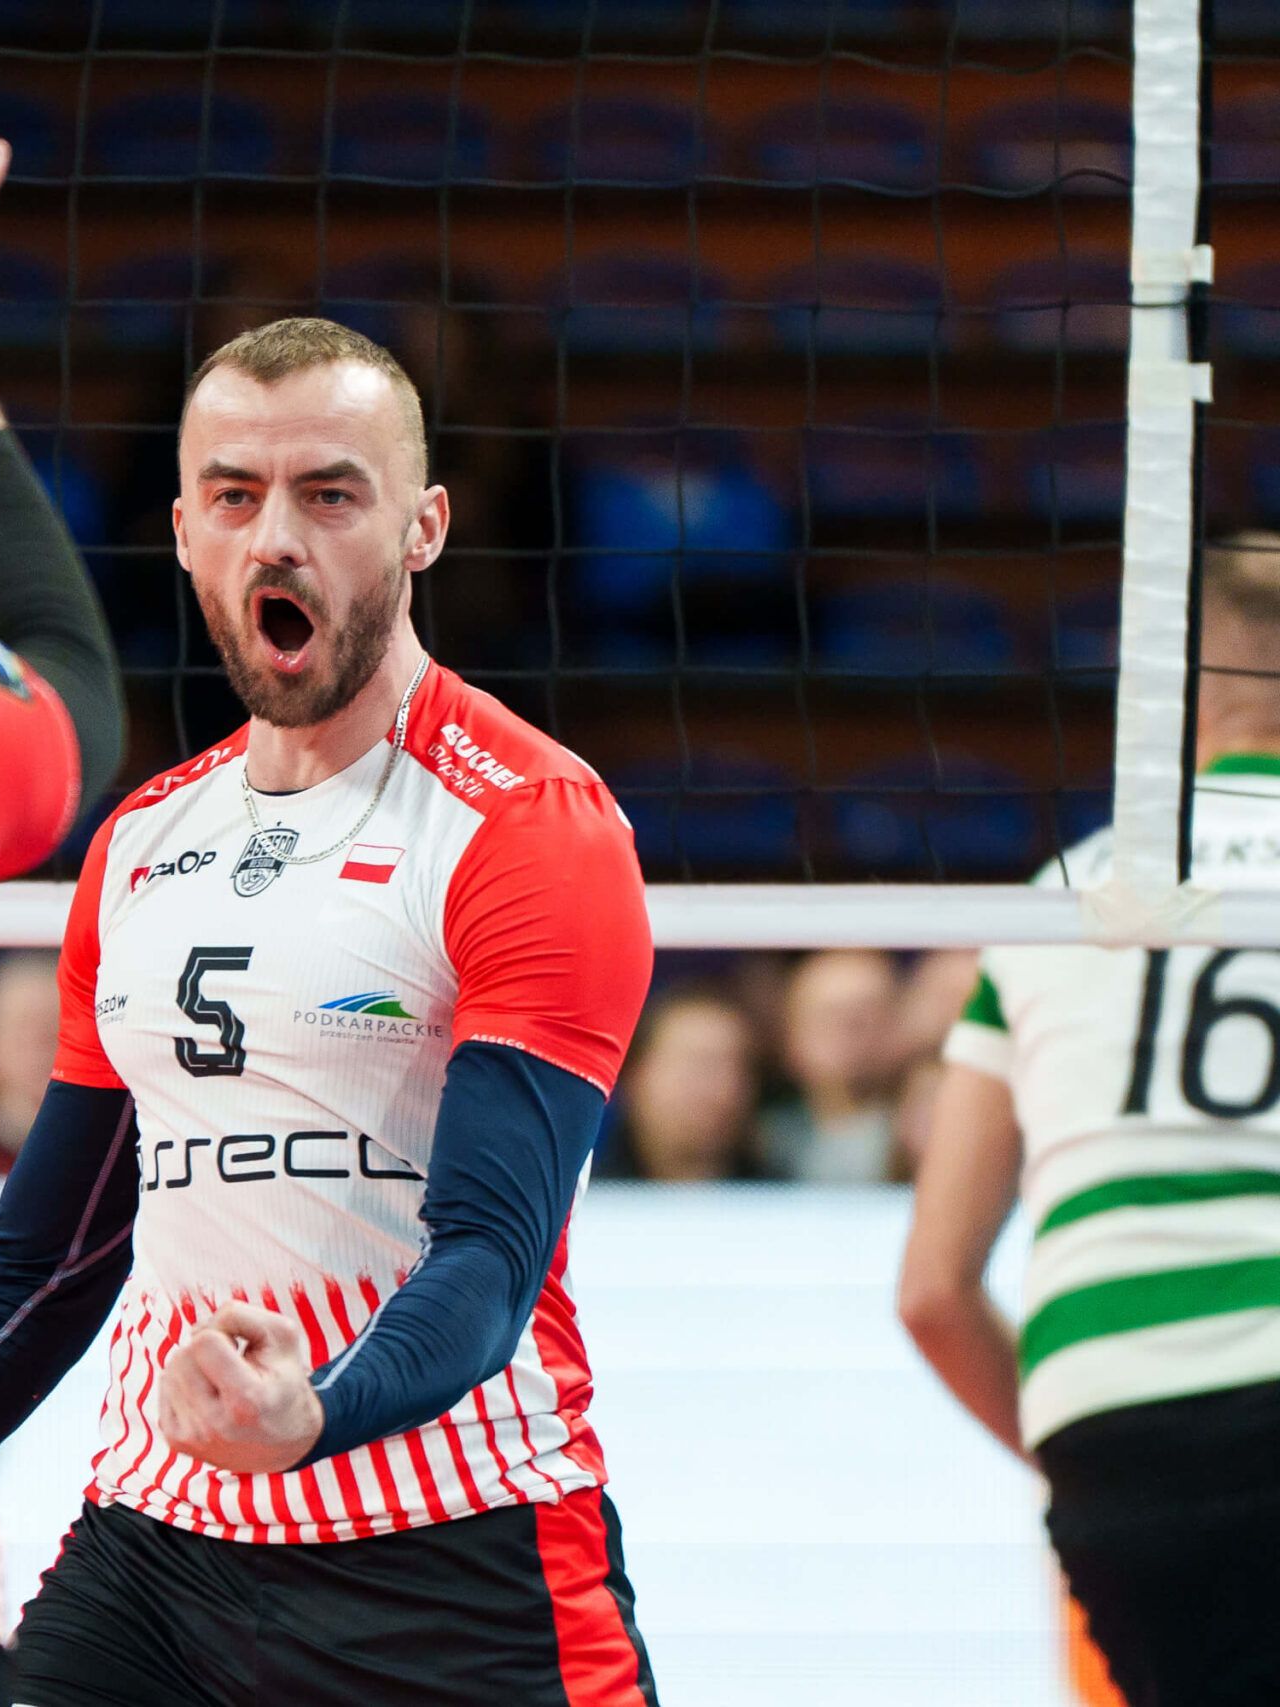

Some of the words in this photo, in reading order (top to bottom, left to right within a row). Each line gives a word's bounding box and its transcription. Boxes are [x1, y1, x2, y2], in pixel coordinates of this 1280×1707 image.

[95, 992, 128, 1018] SZÓW
[174, 946, 254, 1077] 5
[293, 1010, 443, 1038] PODKARPACKIE
[470, 1033, 525, 1050] ASSECO
[1118, 947, 1280, 1120] 16
[136, 1130, 425, 1193] sseco
